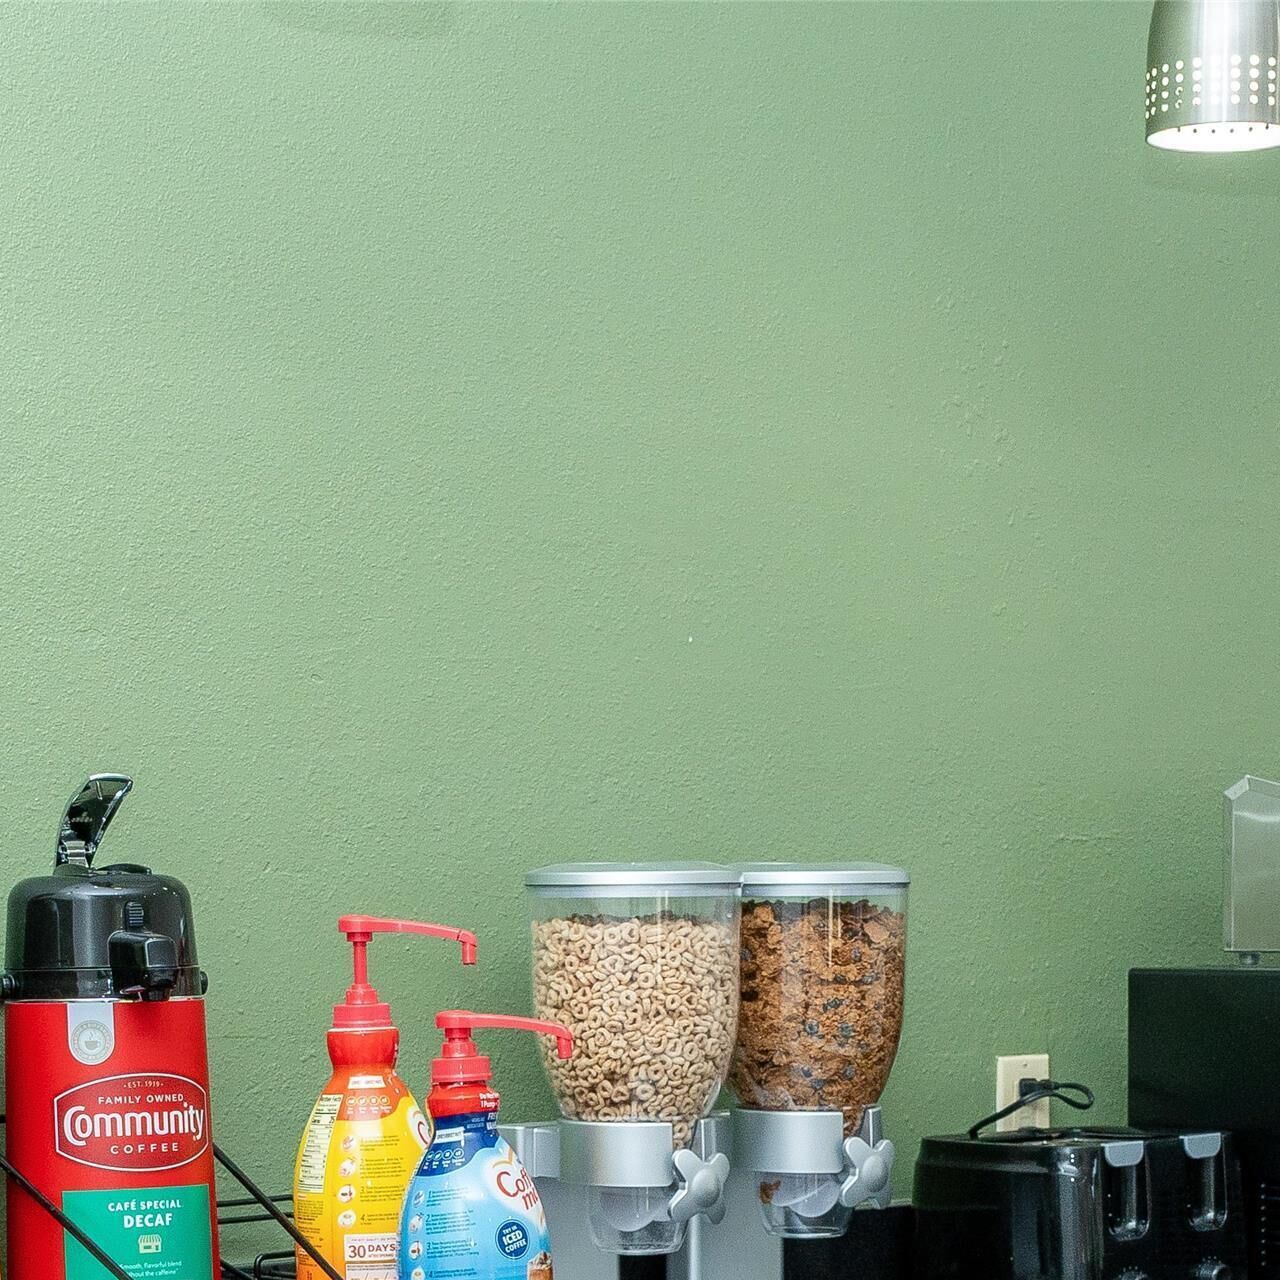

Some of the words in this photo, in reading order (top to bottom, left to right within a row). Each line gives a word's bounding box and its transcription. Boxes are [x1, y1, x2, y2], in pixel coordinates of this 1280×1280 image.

[128, 1081, 143, 1089] EST.
[98, 1095, 142, 1105] FAMILY
[146, 1093, 183, 1103] OWNED
[64, 1102, 204, 1146] Community
[110, 1143, 179, 1155] COFFEE
[107, 1199, 137, 1212] CAFÉ
[140, 1199, 182, 1211] SPECIAL
[123, 1213, 173, 1229] DECAF
[502, 1230, 523, 1245] ICED
[348, 1245, 366, 1258] 30
[368, 1243, 396, 1252] DAYS
[505, 1239, 527, 1253] COFFEE
